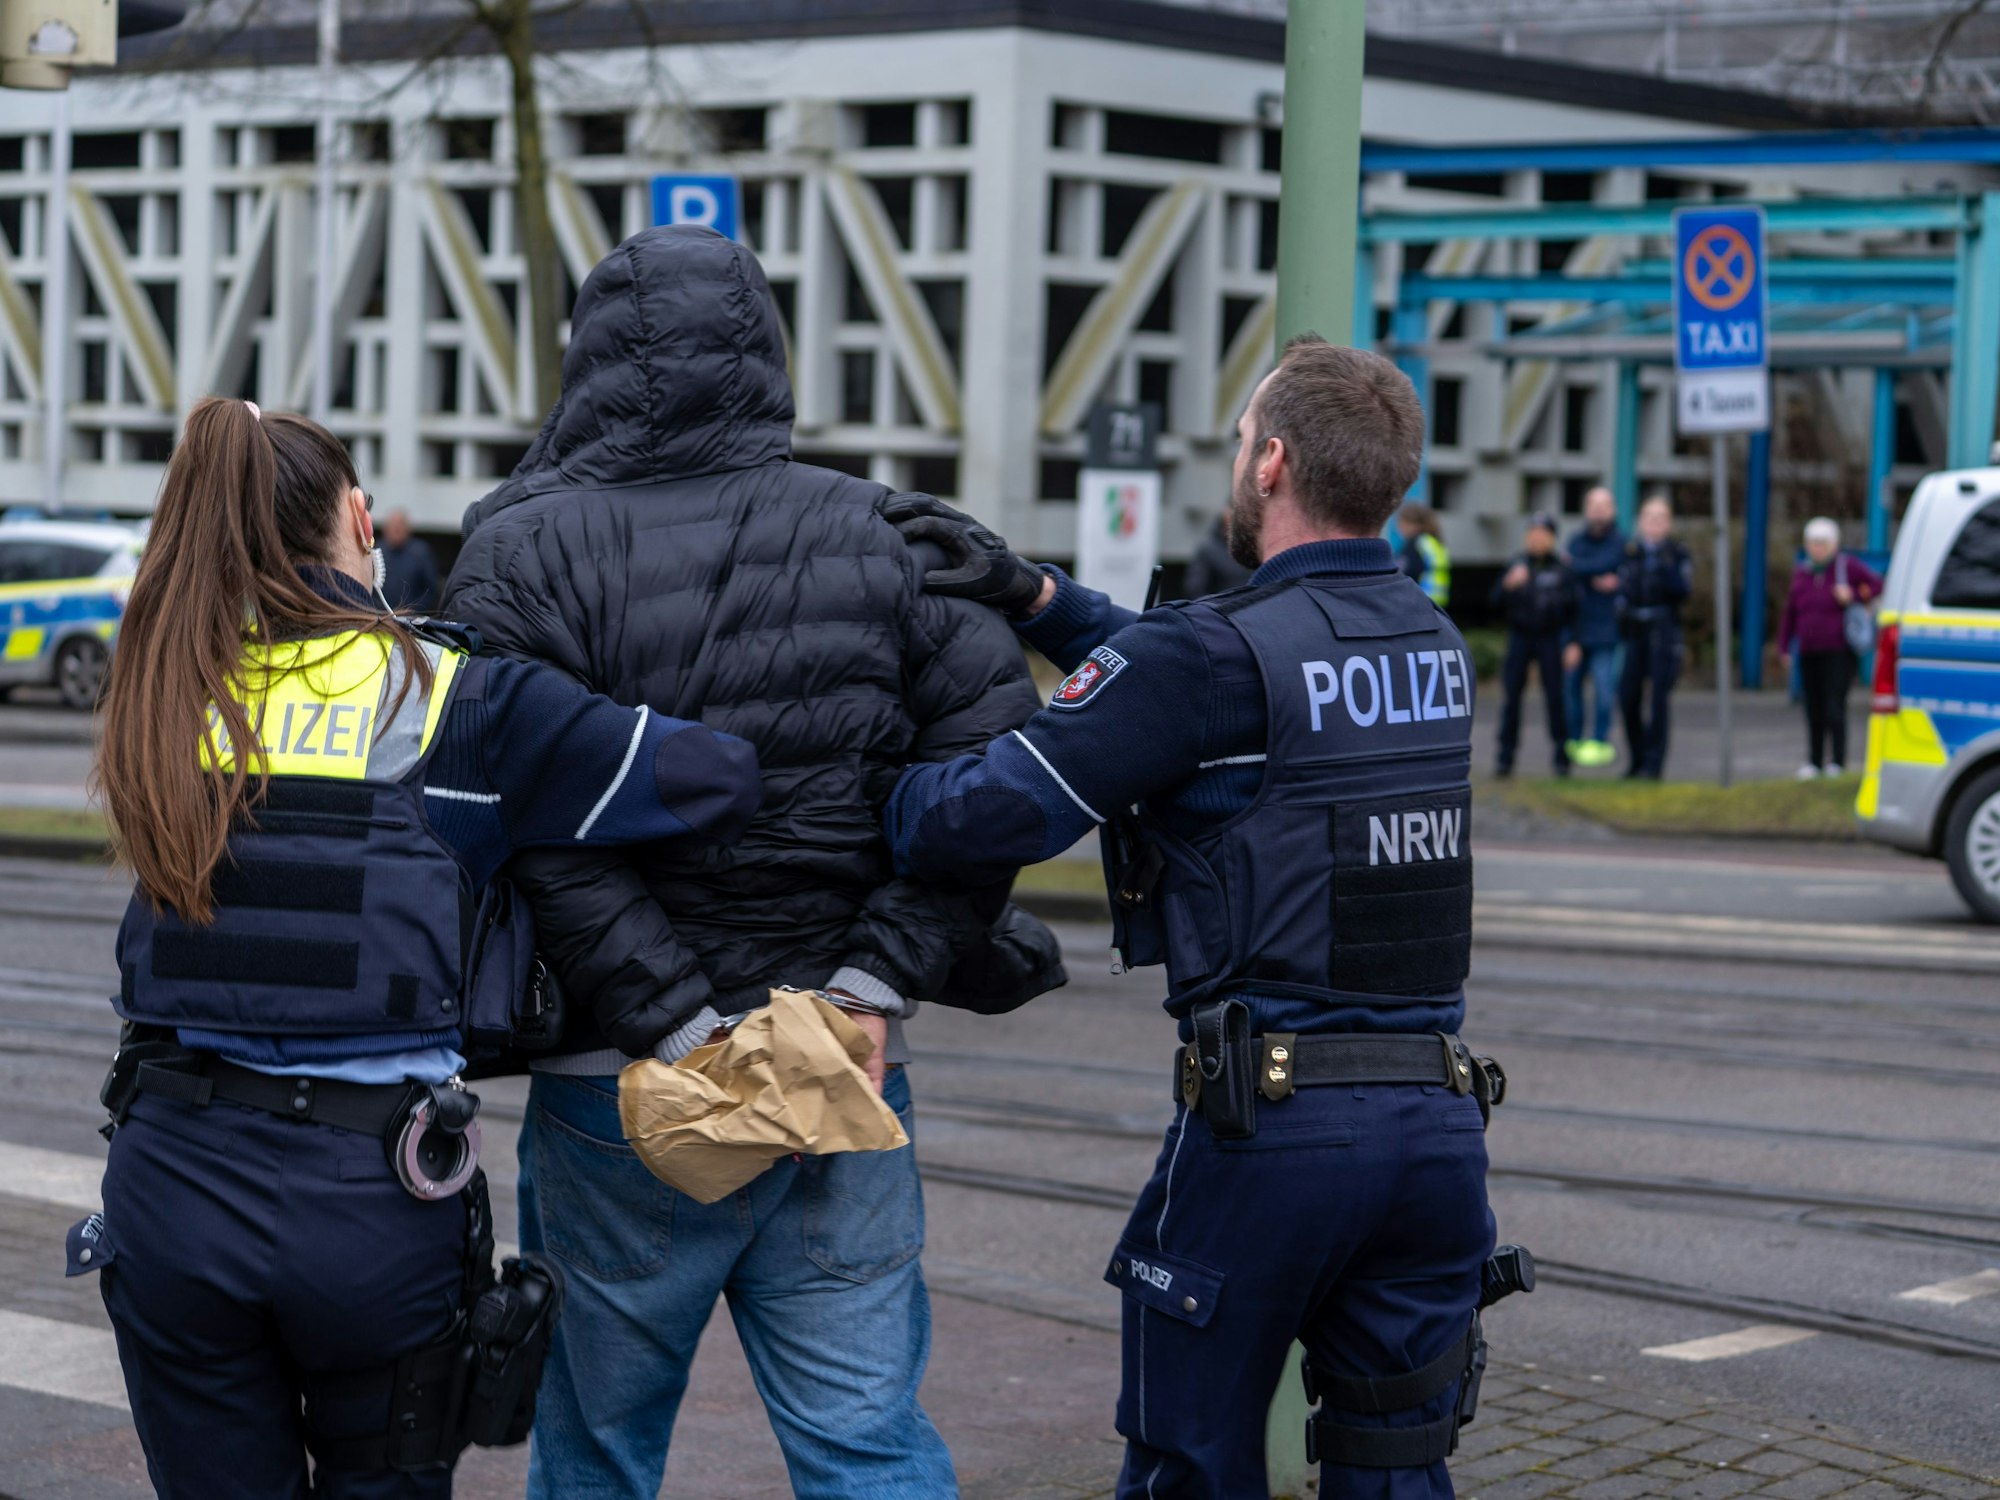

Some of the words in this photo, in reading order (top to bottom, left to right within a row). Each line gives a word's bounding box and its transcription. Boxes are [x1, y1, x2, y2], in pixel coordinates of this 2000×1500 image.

[670, 186, 719, 226] P
[1687, 321, 1758, 355] TAXI
[1301, 649, 1471, 731] POLIZEI
[1369, 808, 1461, 866] NRW
[1130, 1258, 1173, 1291] POLIZEI
